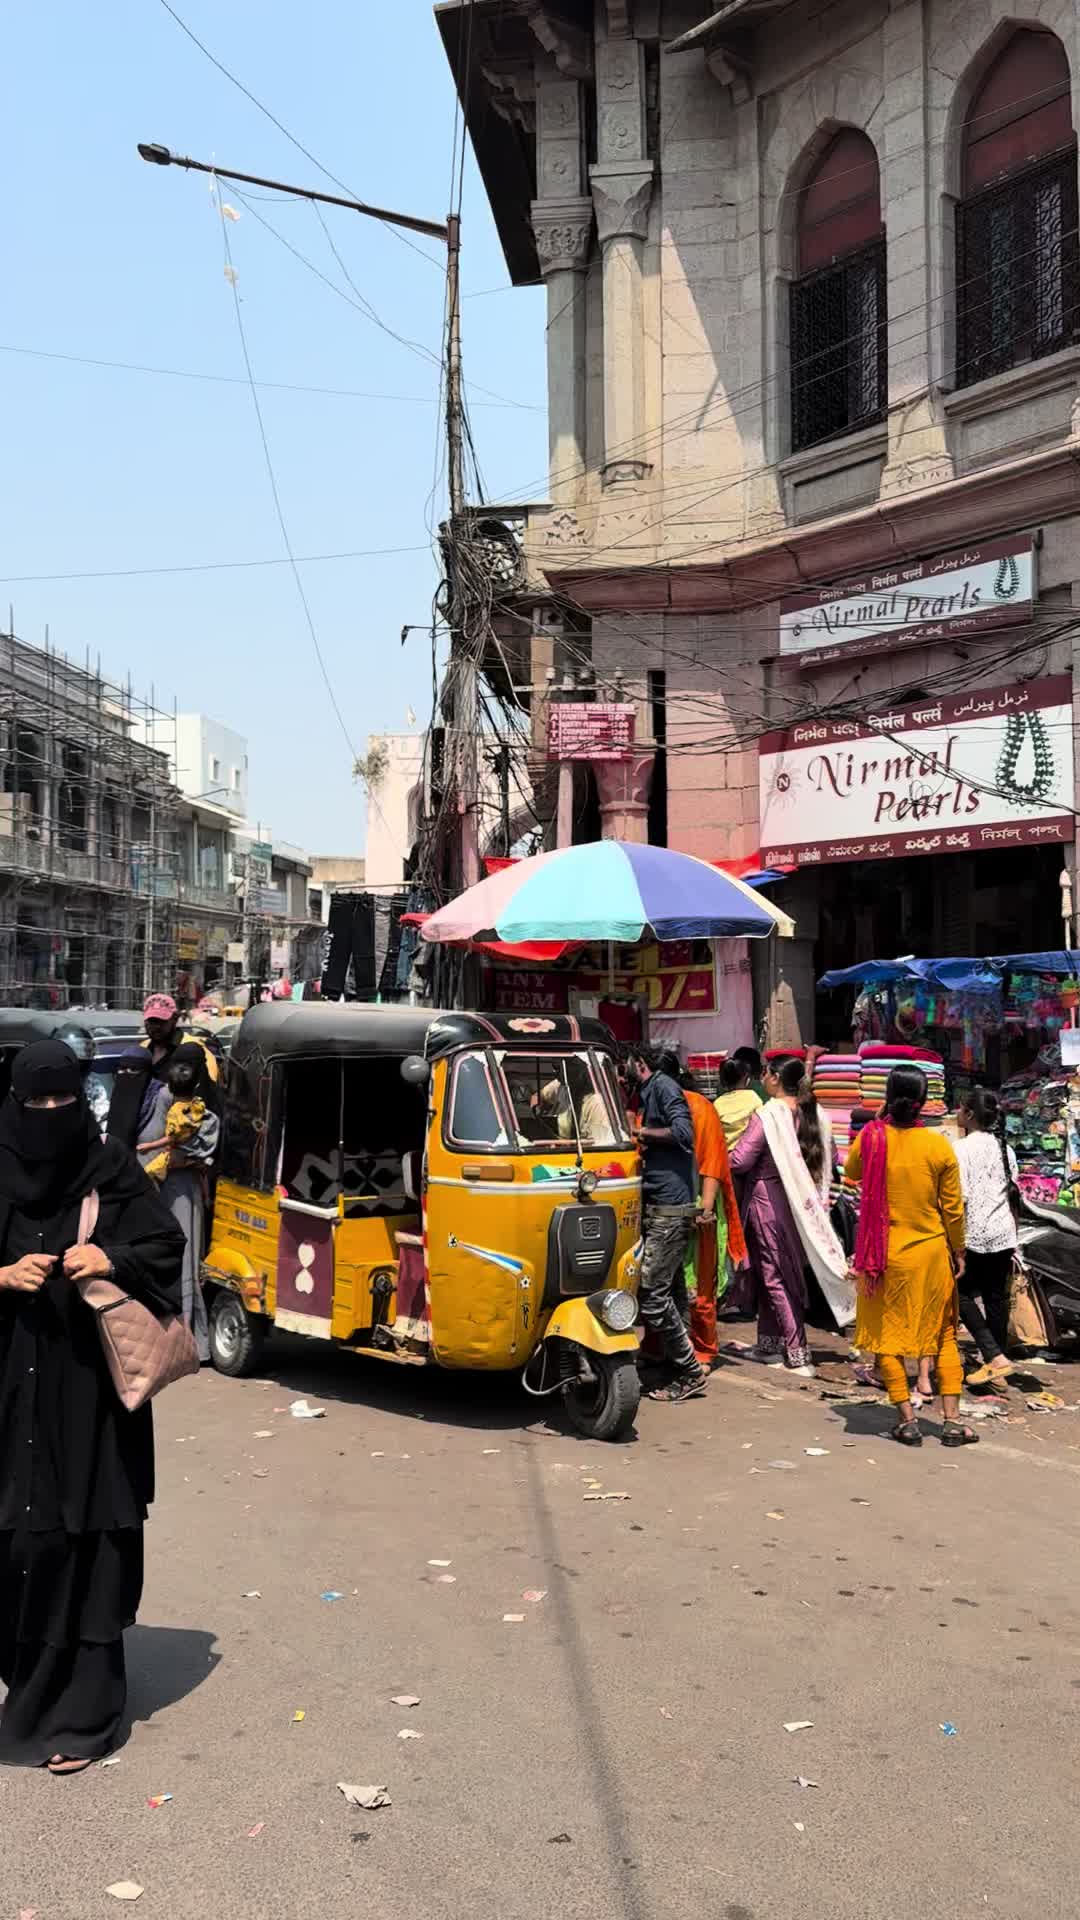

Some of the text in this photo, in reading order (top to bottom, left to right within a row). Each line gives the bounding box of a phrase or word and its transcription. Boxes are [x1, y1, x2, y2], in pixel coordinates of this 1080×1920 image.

[813, 590, 899, 634] Nirmal
[998, 690, 1029, 707] نرمل
[868, 711, 906, 729] निर्मल
[807, 736, 959, 798] Nirmal
[873, 780, 982, 822] Pearls
[496, 991, 557, 1009] TEM
